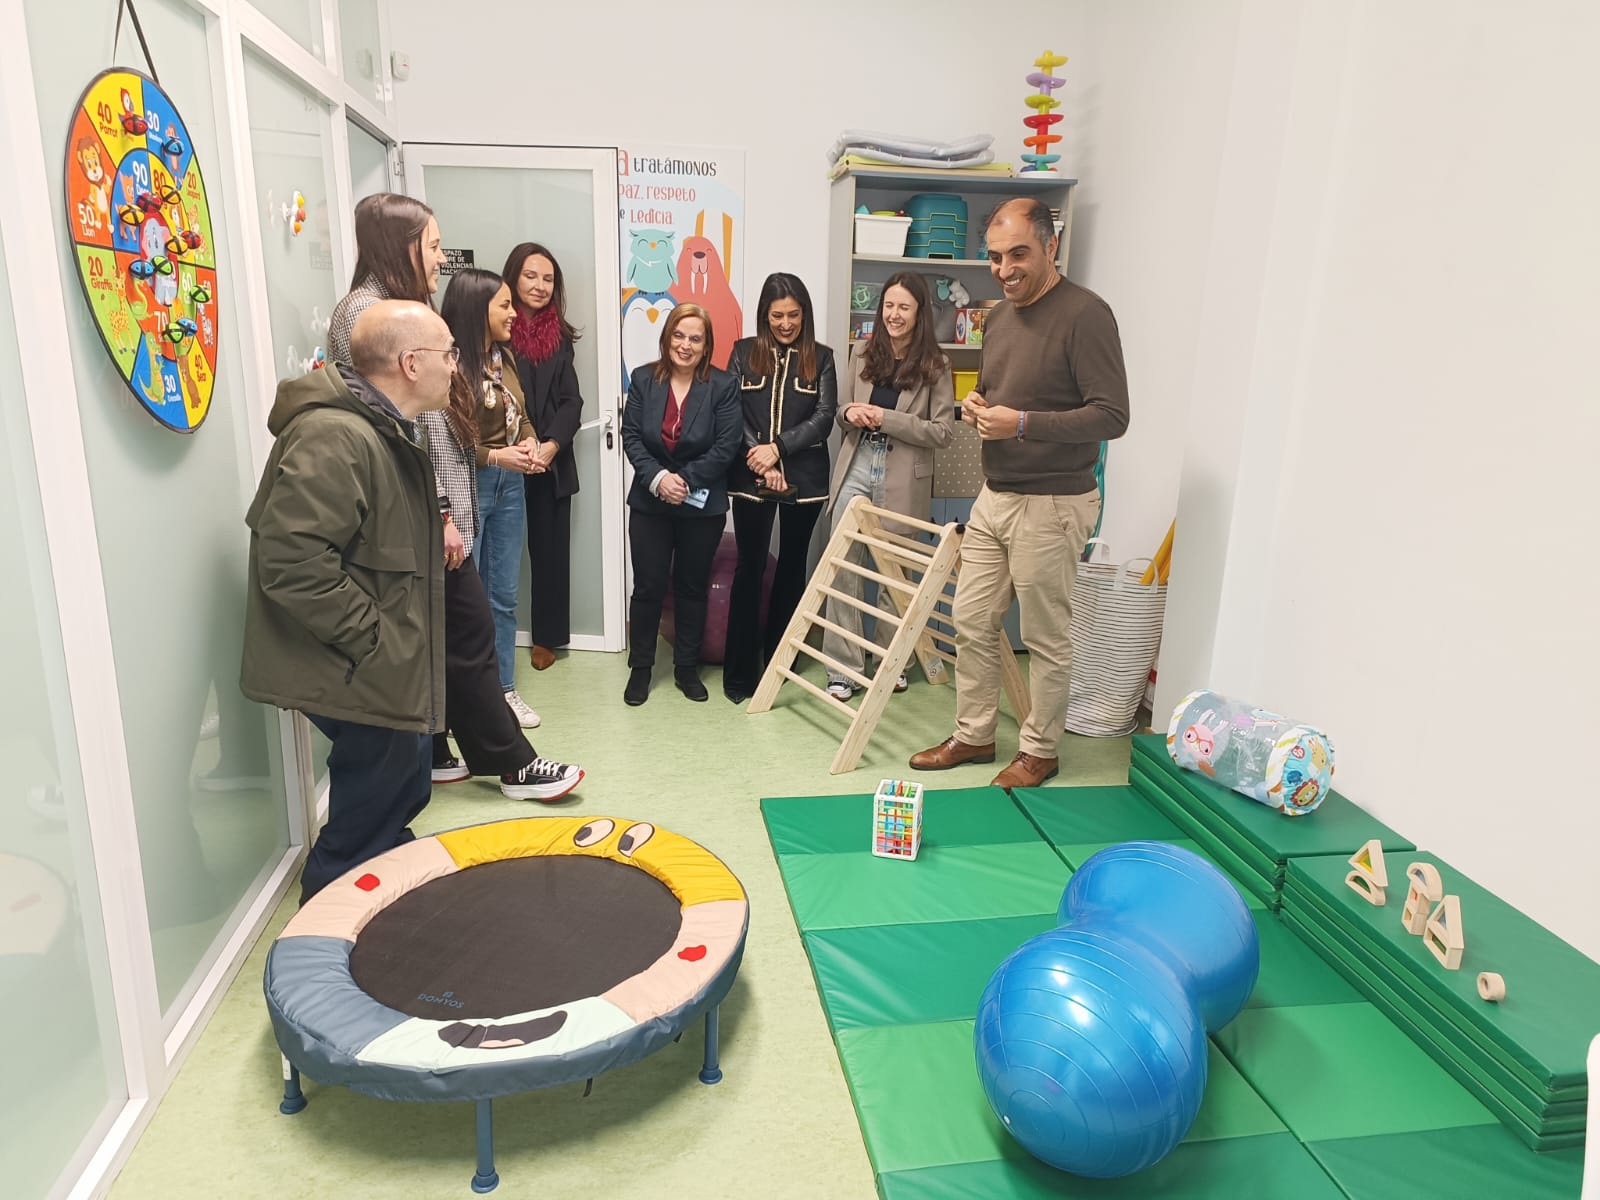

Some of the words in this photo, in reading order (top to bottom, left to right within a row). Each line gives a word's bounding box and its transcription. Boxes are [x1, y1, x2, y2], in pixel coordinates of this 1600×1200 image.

[98, 101, 112, 124] 40
[147, 110, 160, 132] 30
[99, 121, 119, 138] Parrot
[132, 161, 148, 186] 90
[187, 171, 197, 190] 20
[646, 185, 696, 202] respeto
[78, 203, 95, 227] 50
[82, 224, 96, 239] Lion
[88, 255, 104, 277] 20
[91, 277, 114, 291] Giraffe
[182, 272, 193, 292] 60
[195, 354, 203, 370] 40
[164, 375, 177, 393] 30
[417, 993, 465, 1009] DOMYOS
